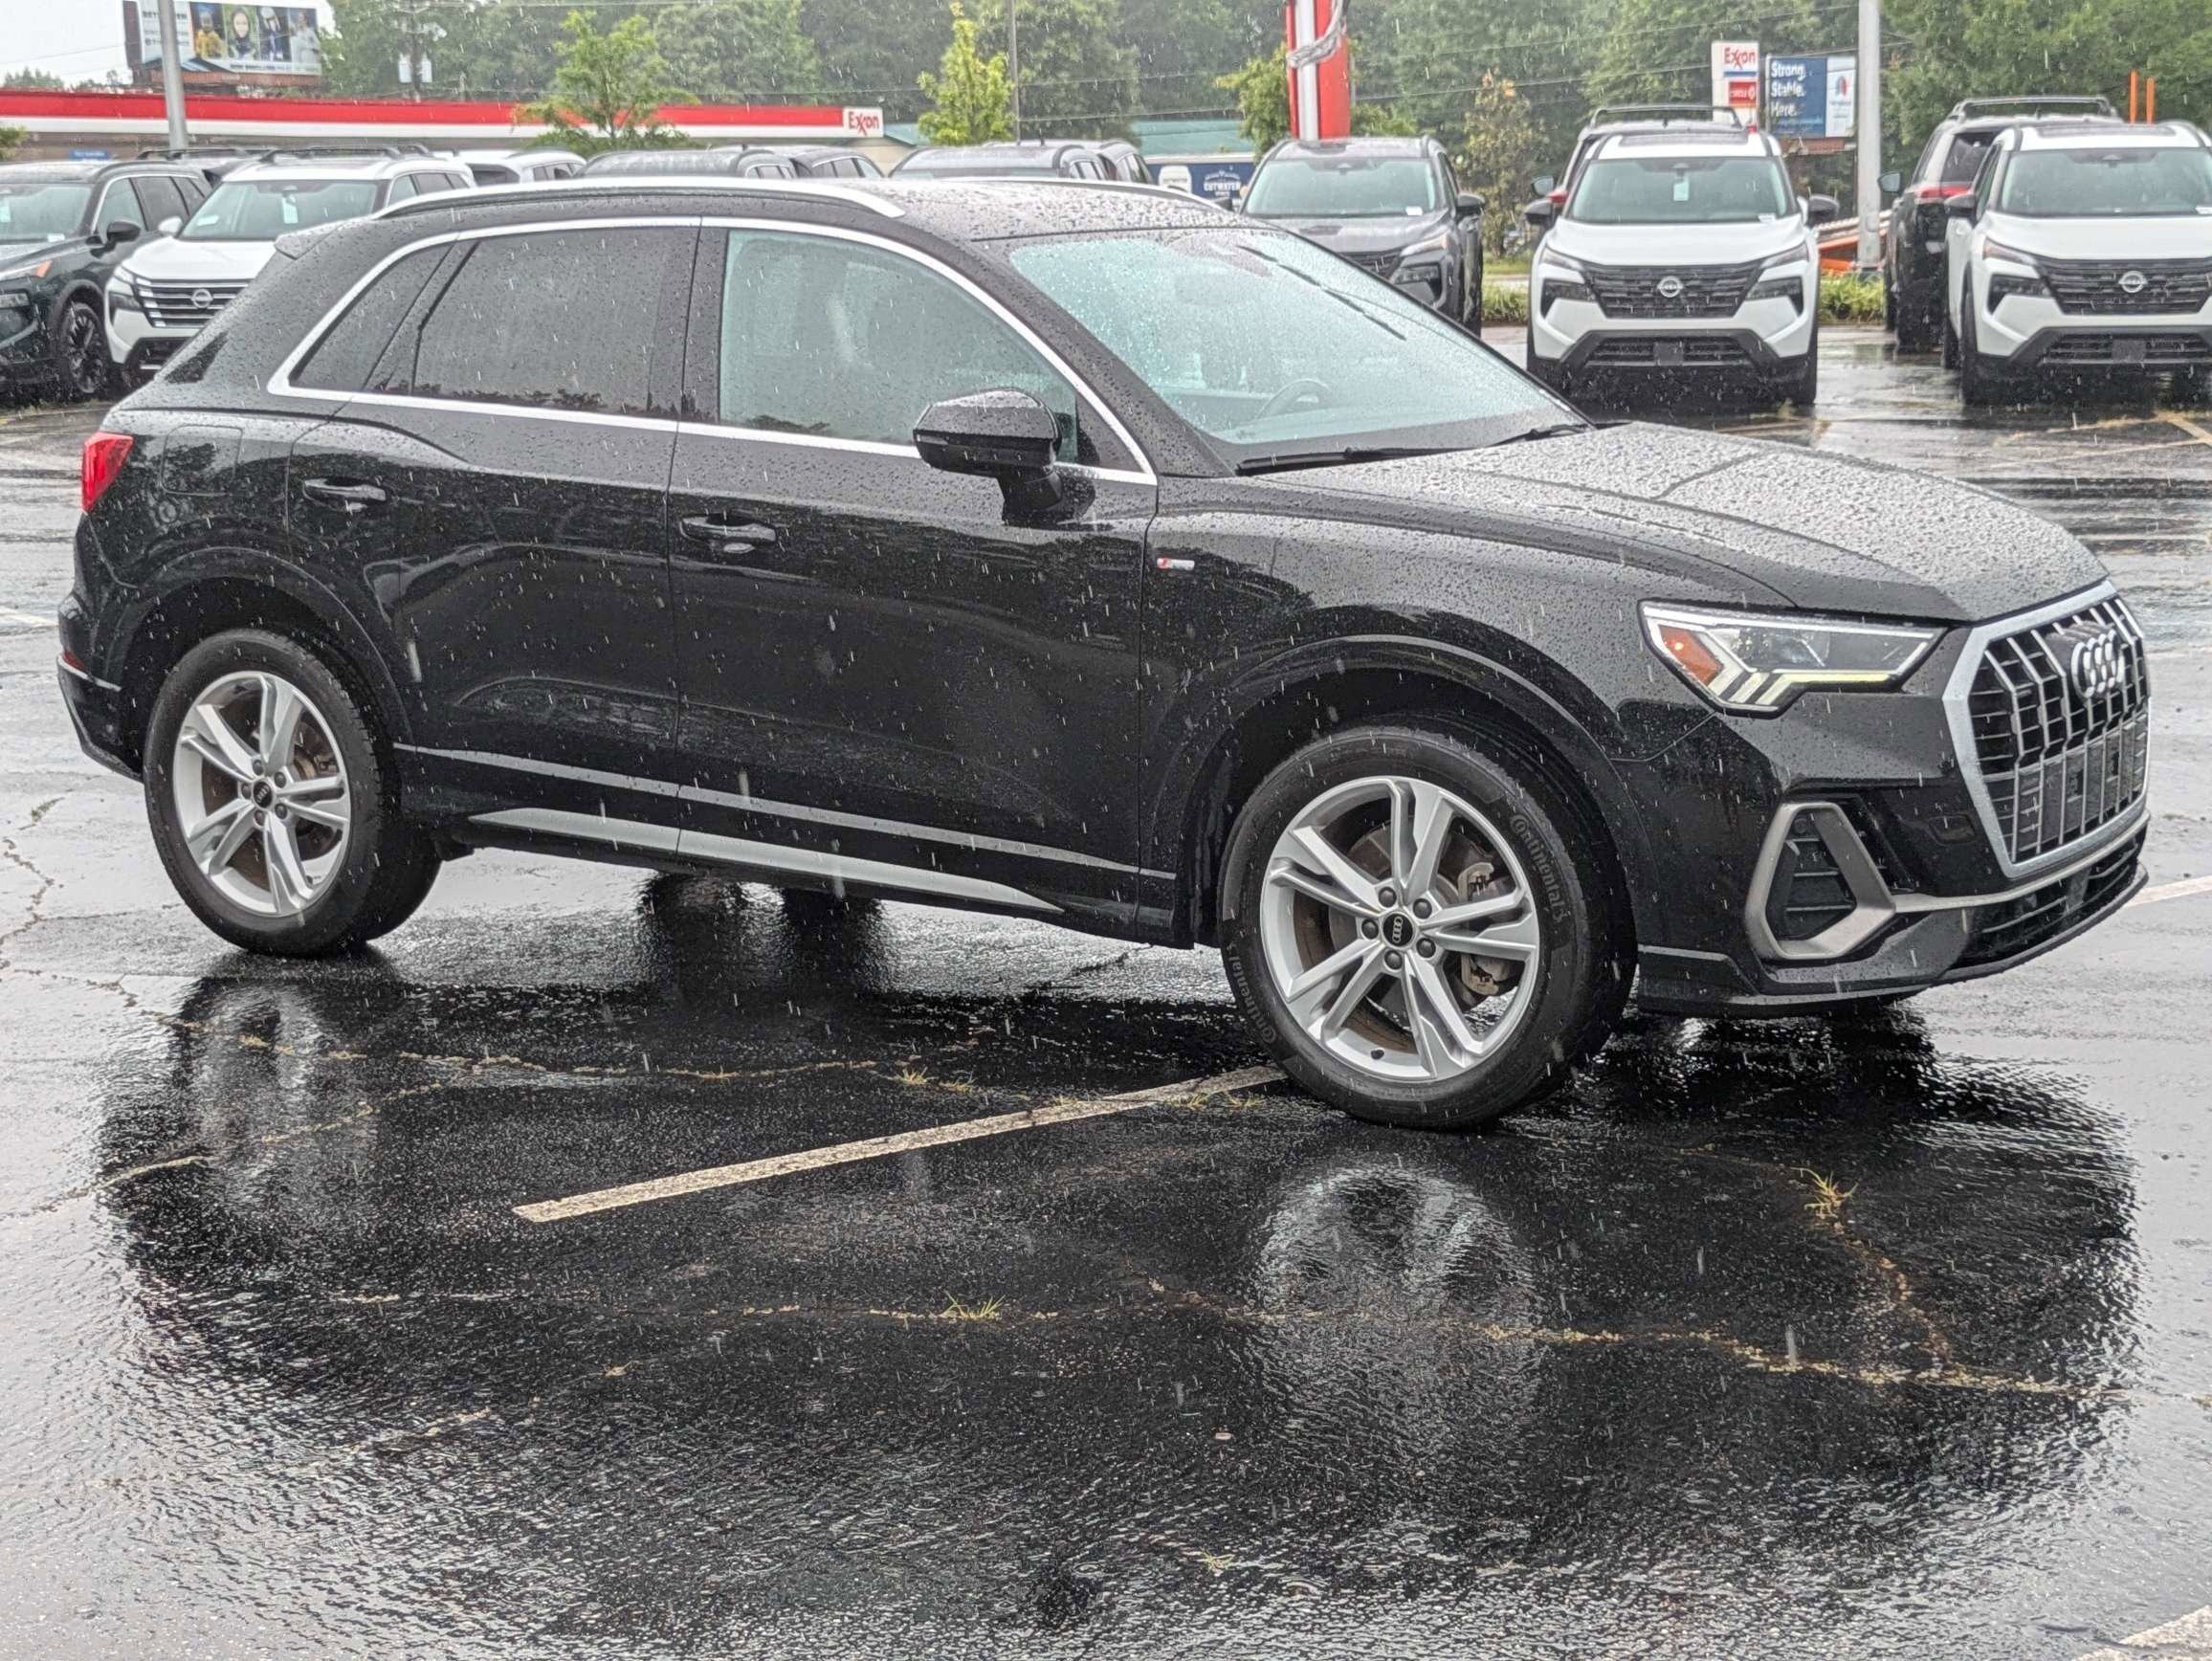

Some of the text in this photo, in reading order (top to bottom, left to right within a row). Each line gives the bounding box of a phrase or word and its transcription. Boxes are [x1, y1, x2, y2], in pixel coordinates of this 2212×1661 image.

[1724, 47, 1756, 70] Exxon
[849, 111, 879, 137] Exxon
[1510, 813, 1566, 908] Continental
[1228, 956, 1276, 1043] Continental
